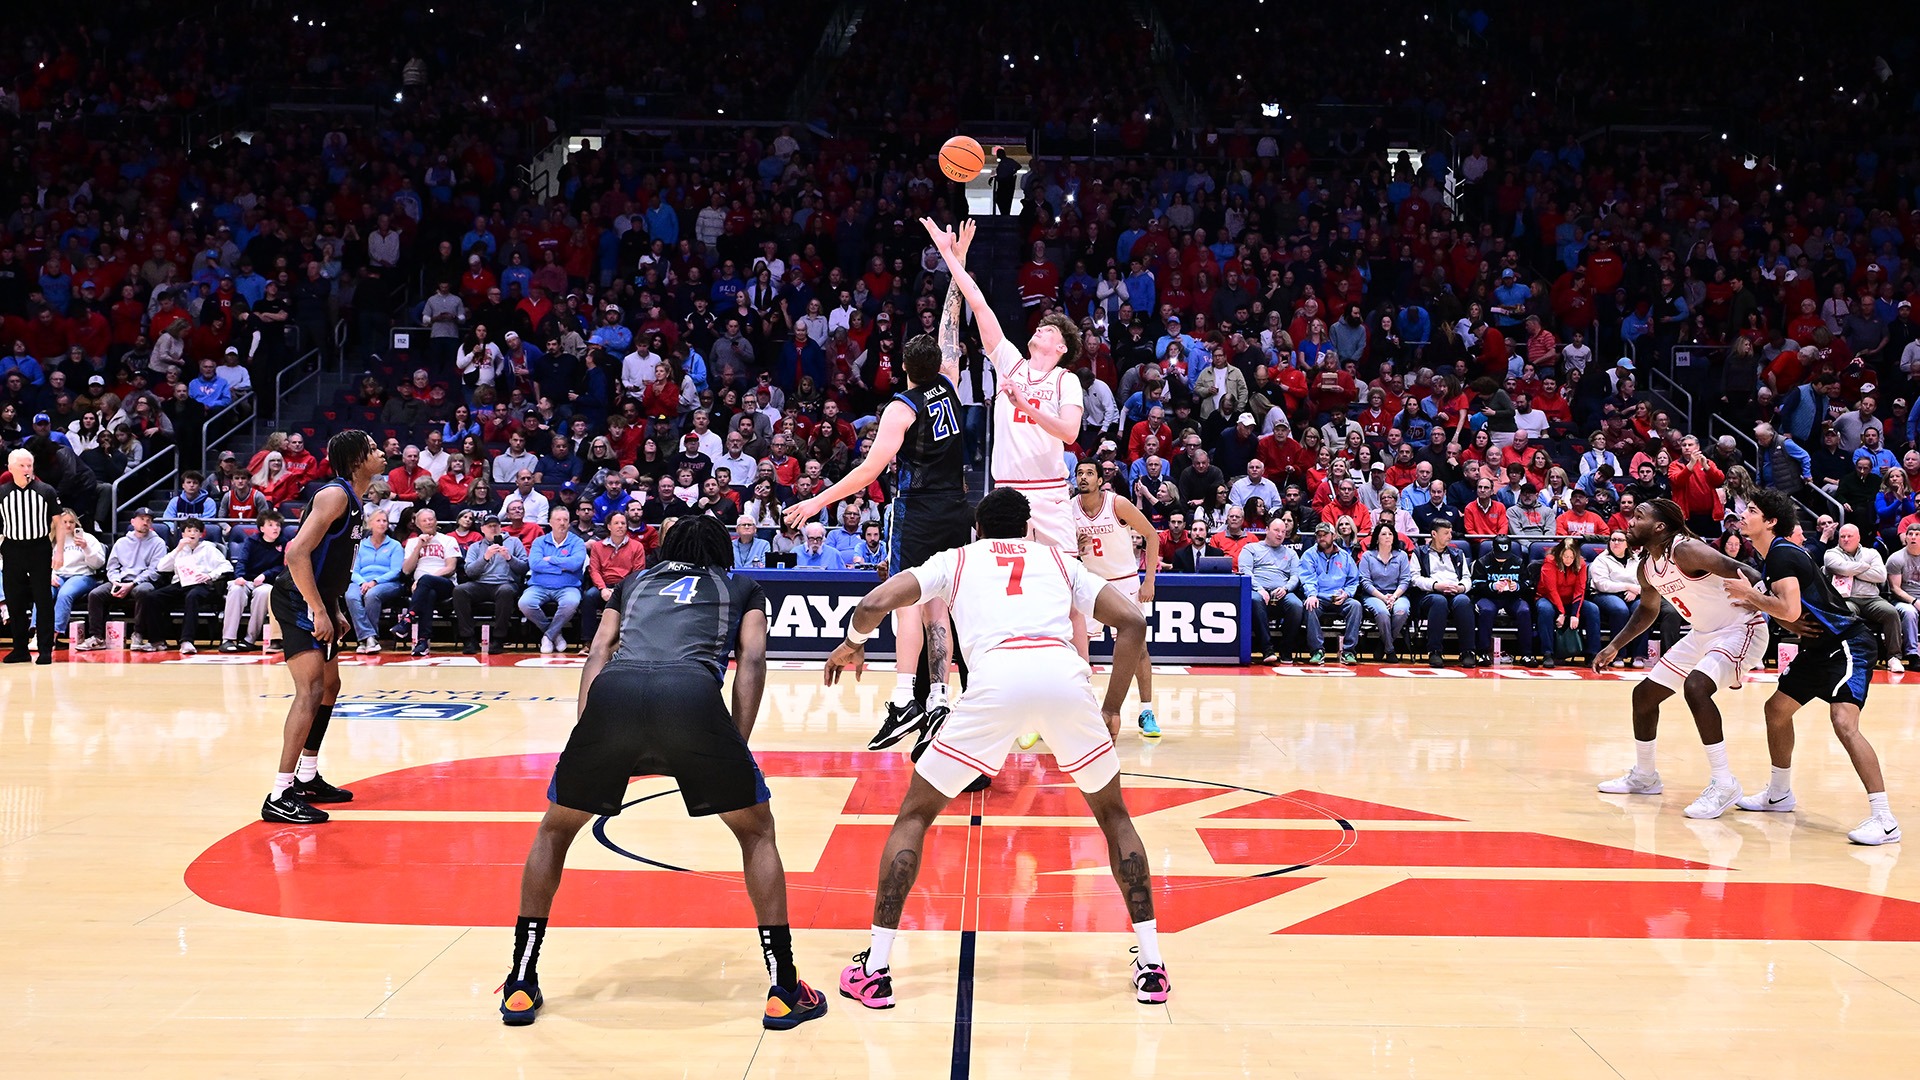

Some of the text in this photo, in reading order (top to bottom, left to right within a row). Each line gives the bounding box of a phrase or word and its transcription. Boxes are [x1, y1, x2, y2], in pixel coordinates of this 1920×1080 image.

[927, 397, 960, 442] 21
[1077, 525, 1114, 534] DAYTON
[989, 541, 1027, 555] JONES
[1092, 538, 1104, 557] 2
[996, 556, 1025, 596] 7
[658, 575, 701, 604] 4
[1672, 596, 1692, 618] 3
